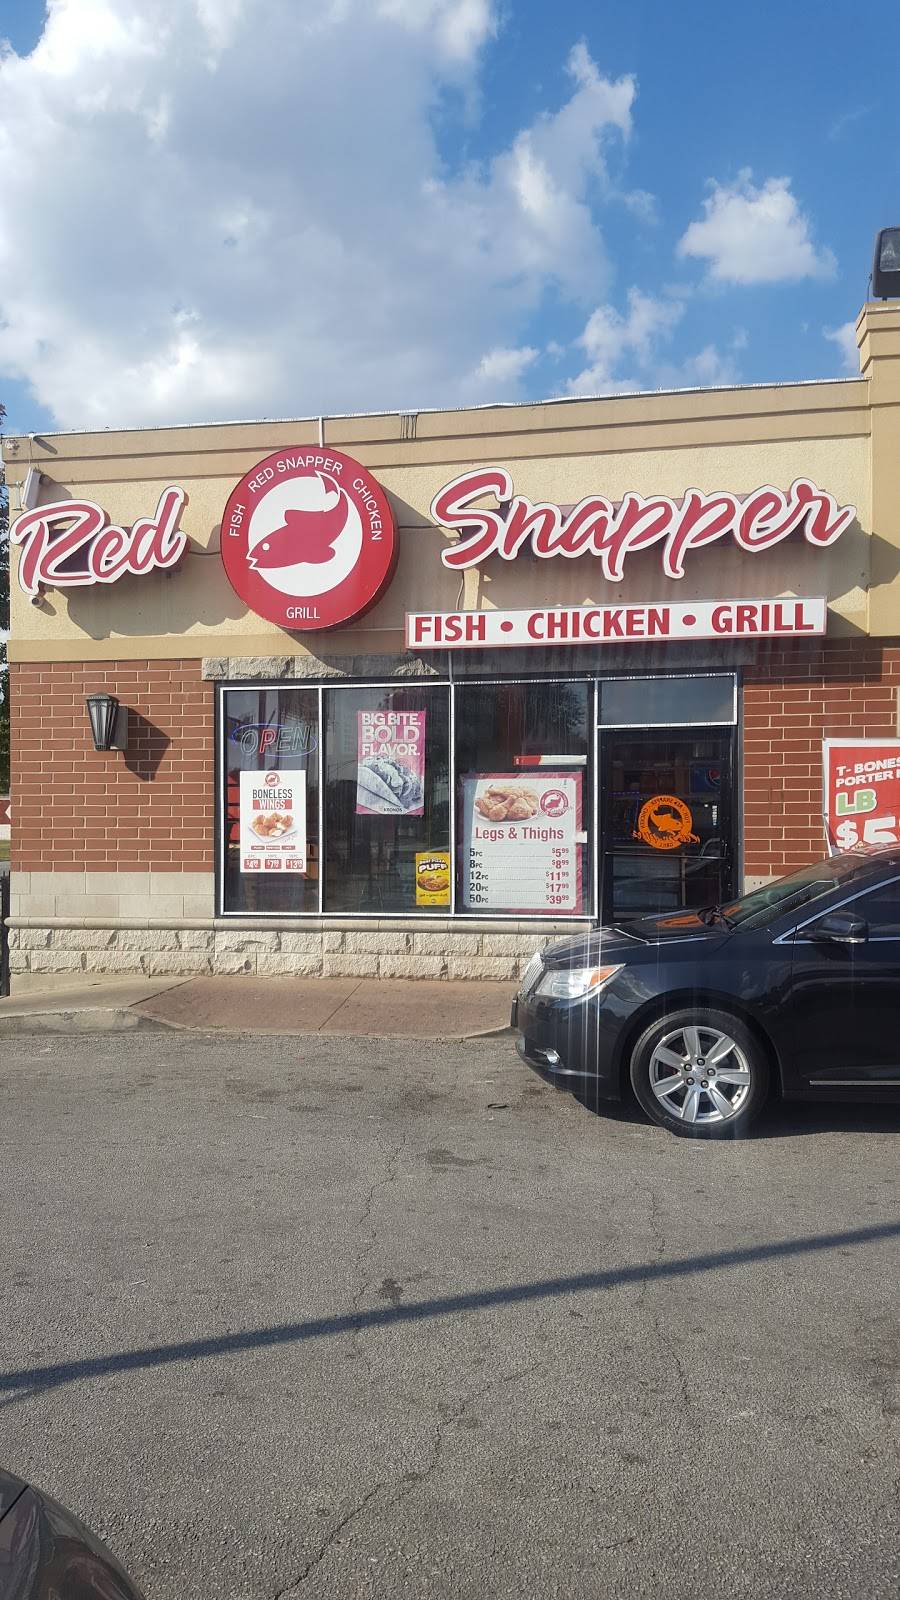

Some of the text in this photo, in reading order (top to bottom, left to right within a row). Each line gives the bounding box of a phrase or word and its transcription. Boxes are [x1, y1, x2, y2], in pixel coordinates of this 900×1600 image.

[248, 455, 343, 493] RED SNAPPER
[352, 478, 383, 541] CHICKEN
[229, 503, 246, 537] FISH
[10, 467, 857, 595] Red Snapper
[286, 606, 320, 619] GRILL
[414, 603, 814, 643] FISH CHICKEN GRILL
[361, 712, 421, 726] BIG BITE.
[240, 725, 311, 755] OPEN
[361, 725, 420, 743] BOLD
[361, 743, 420, 756] FLAVOR.
[835, 770, 894, 788] PORTER
[252, 788, 293, 799] BONELESS
[836, 788, 877, 817] LB
[259, 799, 286, 810] WINGS
[475, 827, 564, 841] Legs & Thighs
[836, 816, 900, 850] $5
[418, 863, 448, 874] PUFF
